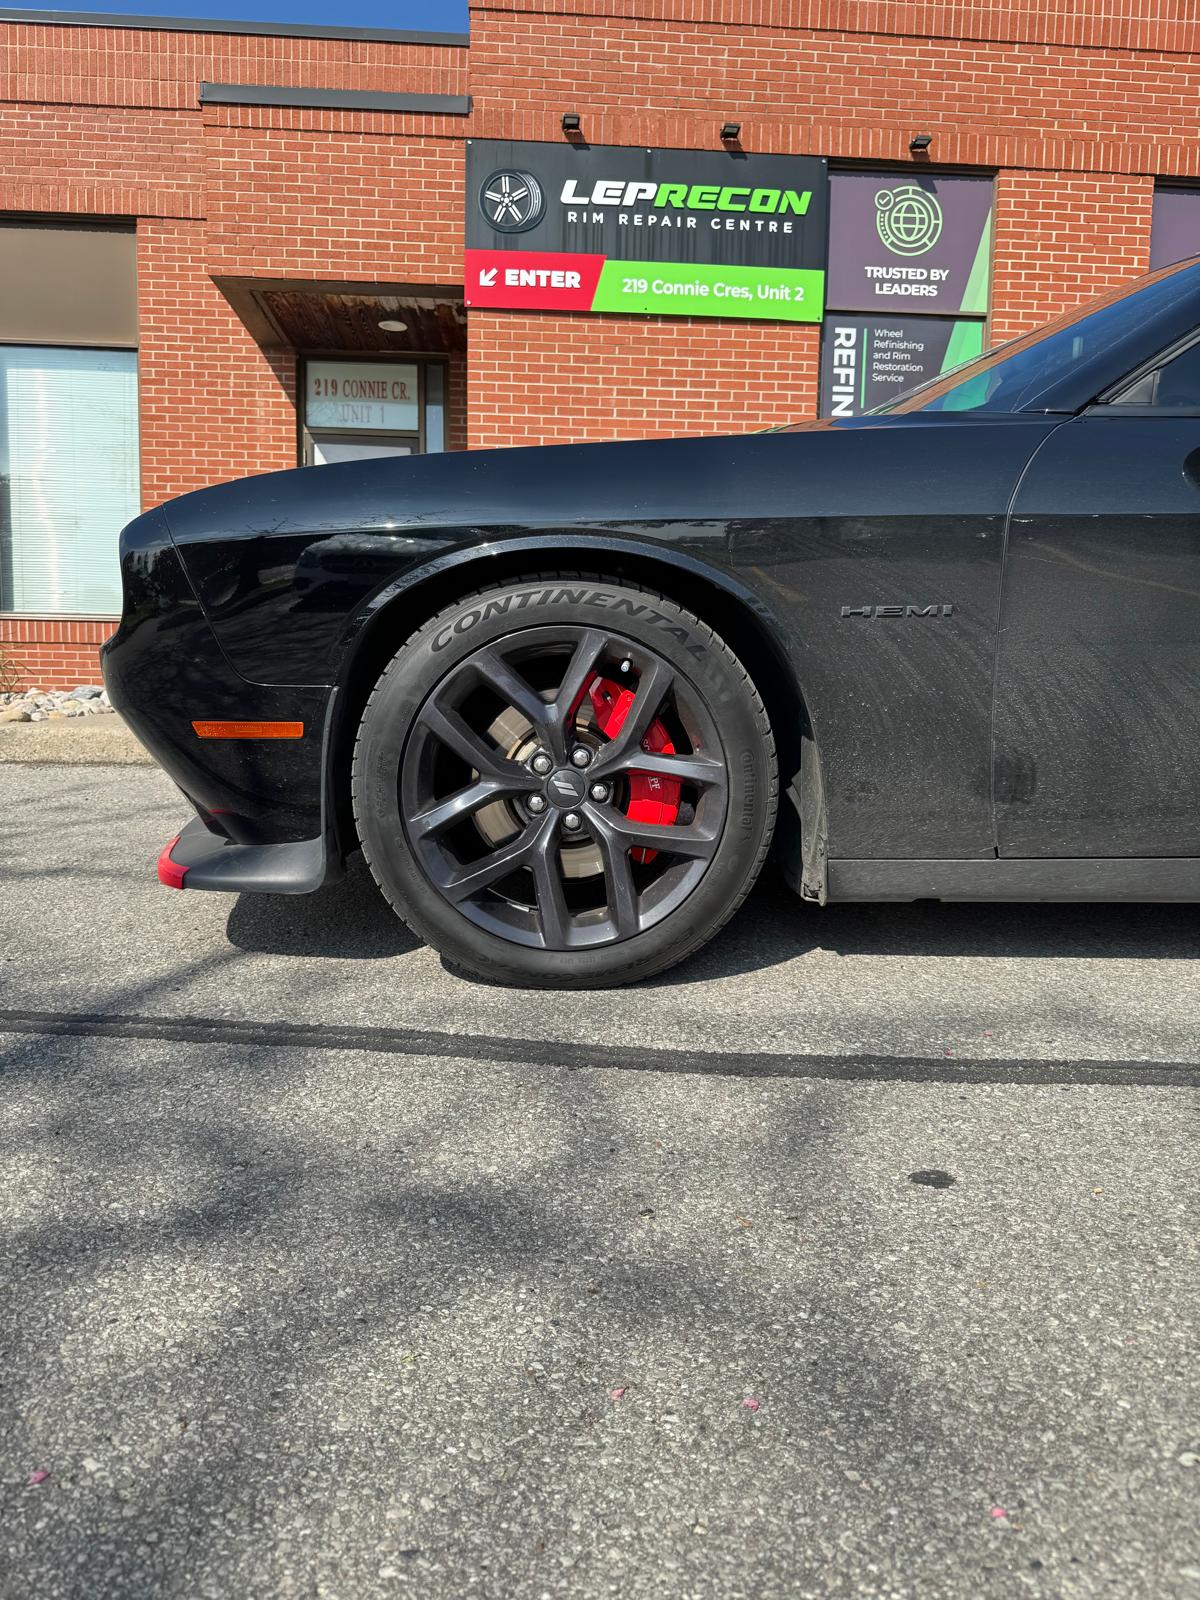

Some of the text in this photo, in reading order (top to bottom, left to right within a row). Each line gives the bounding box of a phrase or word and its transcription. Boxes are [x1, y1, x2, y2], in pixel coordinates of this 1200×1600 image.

[560, 179, 812, 215] LEPRECON
[567, 211, 793, 234] RIM REPAIR CENTRE
[505, 269, 580, 288] ENTER
[864, 266, 950, 281] TRUSTED BY
[622, 278, 805, 301] 219 Connie Cres, Unit 2
[875, 282, 938, 297] LEADERS
[874, 329, 903, 338] Wheel
[873, 340, 924, 351] Refinishing
[892, 352, 911, 361] Rim
[872, 362, 923, 372] Restoration
[872, 373, 904, 383] Service
[314, 378, 411, 400] 219 CONNIE CR.
[341, 404, 372, 424] UNIT
[841, 605, 953, 618] HEMI
[431, 588, 709, 662] CONTINENTAL
